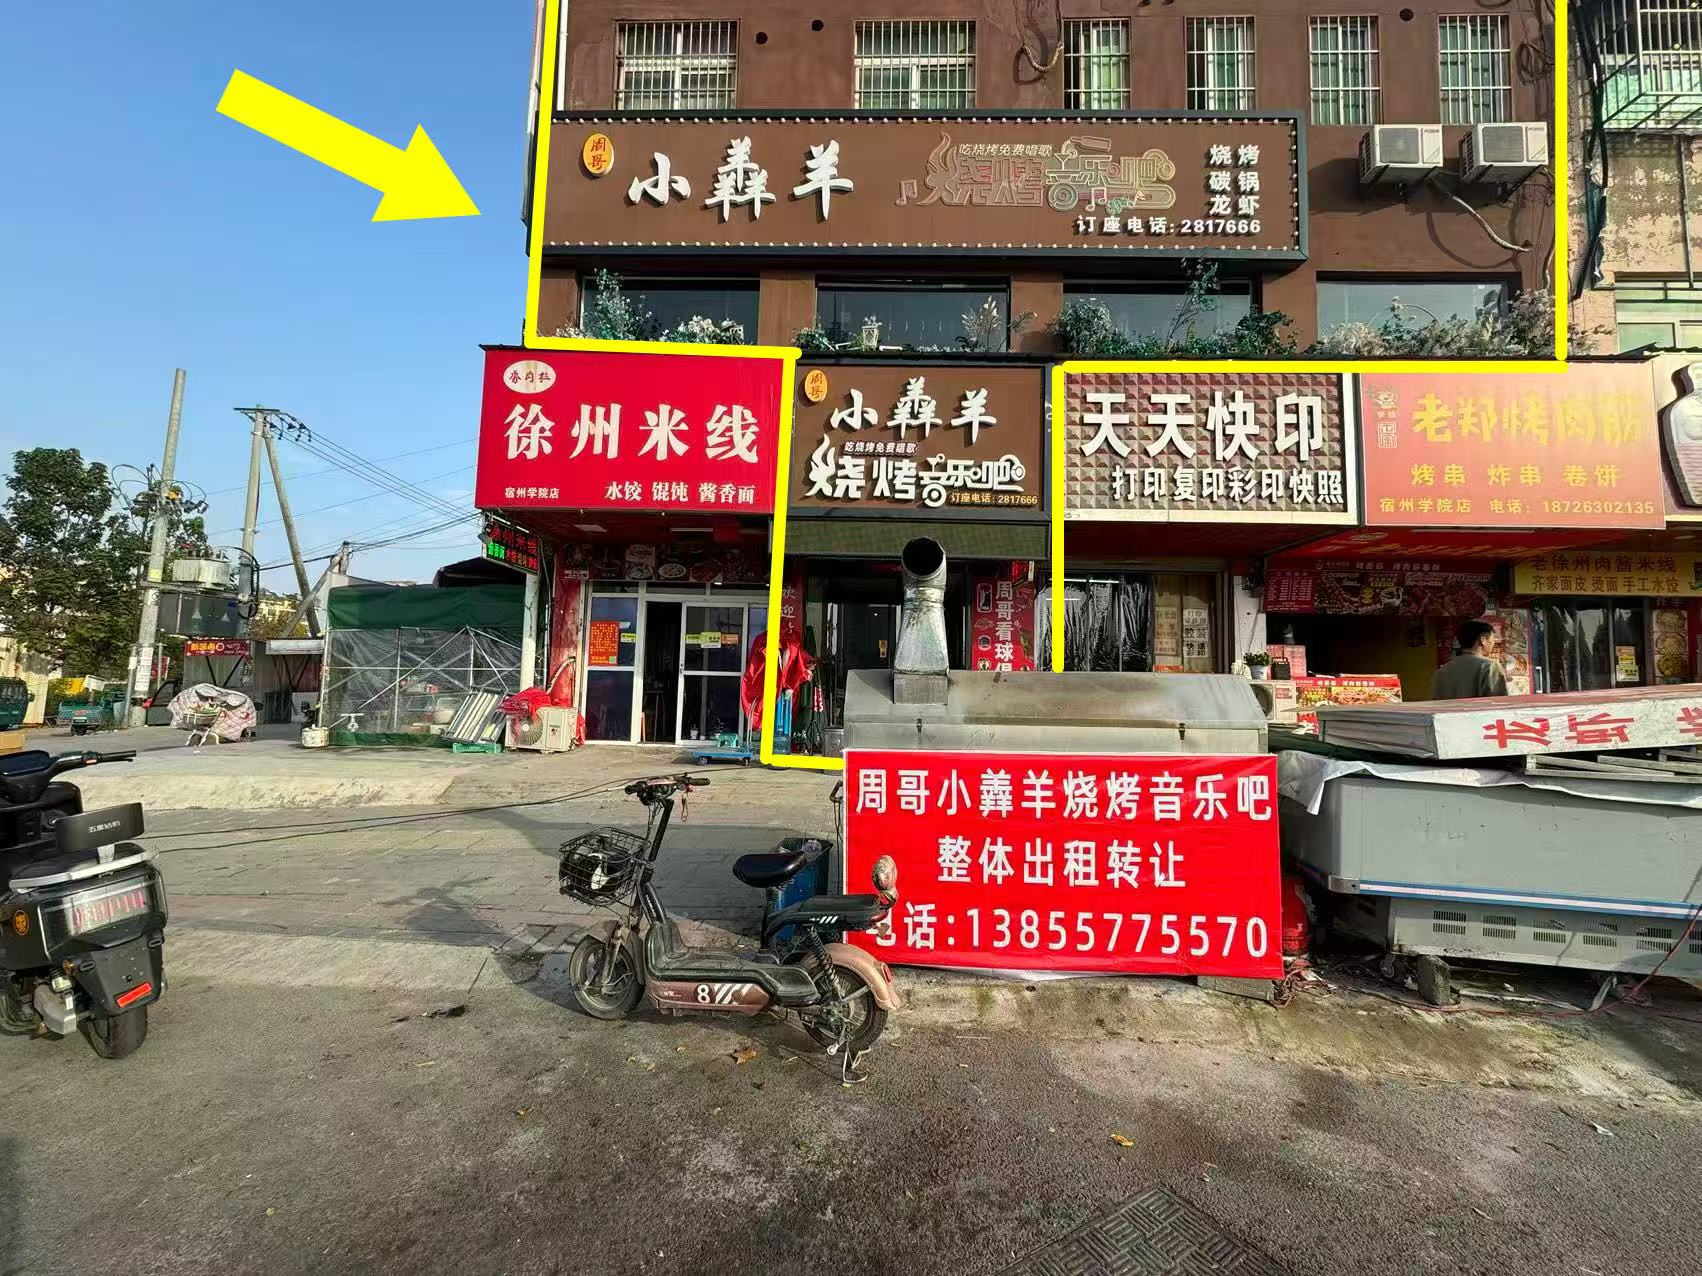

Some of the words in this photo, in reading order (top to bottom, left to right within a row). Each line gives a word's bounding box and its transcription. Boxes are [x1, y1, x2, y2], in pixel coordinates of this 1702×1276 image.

[587, 137, 607, 170] 周哥
[958, 143, 1052, 158] 吃烧烤免费唱歌
[1209, 144, 1260, 166] 烧烤
[1209, 170, 1260, 192] 碳锅
[1209, 194, 1260, 216] 龙虾
[503, 403, 759, 464] 徐州米线
[1081, 390, 1324, 461] 天天快印
[844, 440, 917, 455] 吃烧烤免费唱歌
[805, 433, 1026, 507] 烧烤音乐吧
[1411, 464, 1466, 487] 烤串
[1488, 464, 1542, 487] 炸串
[1563, 464, 1621, 488] 卷饼
[504, 486, 560, 499] 宿州学院店
[604, 481, 642, 501] 水饺
[652, 482, 689, 502] 馄饨
[699, 483, 756, 504] 酱香面
[1112, 464, 1345, 504] 打印复印彩印快照
[1380, 497, 1472, 513] 宿州学院店
[1542, 499, 1654, 515] 18726302135
[1533, 554, 1678, 573] 老徐州肉酱米线
[1623, 576, 1680, 593] 手工水饺
[1482, 712, 1635, 749] 龙虾
[856, 767, 1272, 822] 周哥小羴羊烧烤音乐吧
[937, 835, 1187, 889] 整体出租转让
[697, 984, 711, 1004] 8
